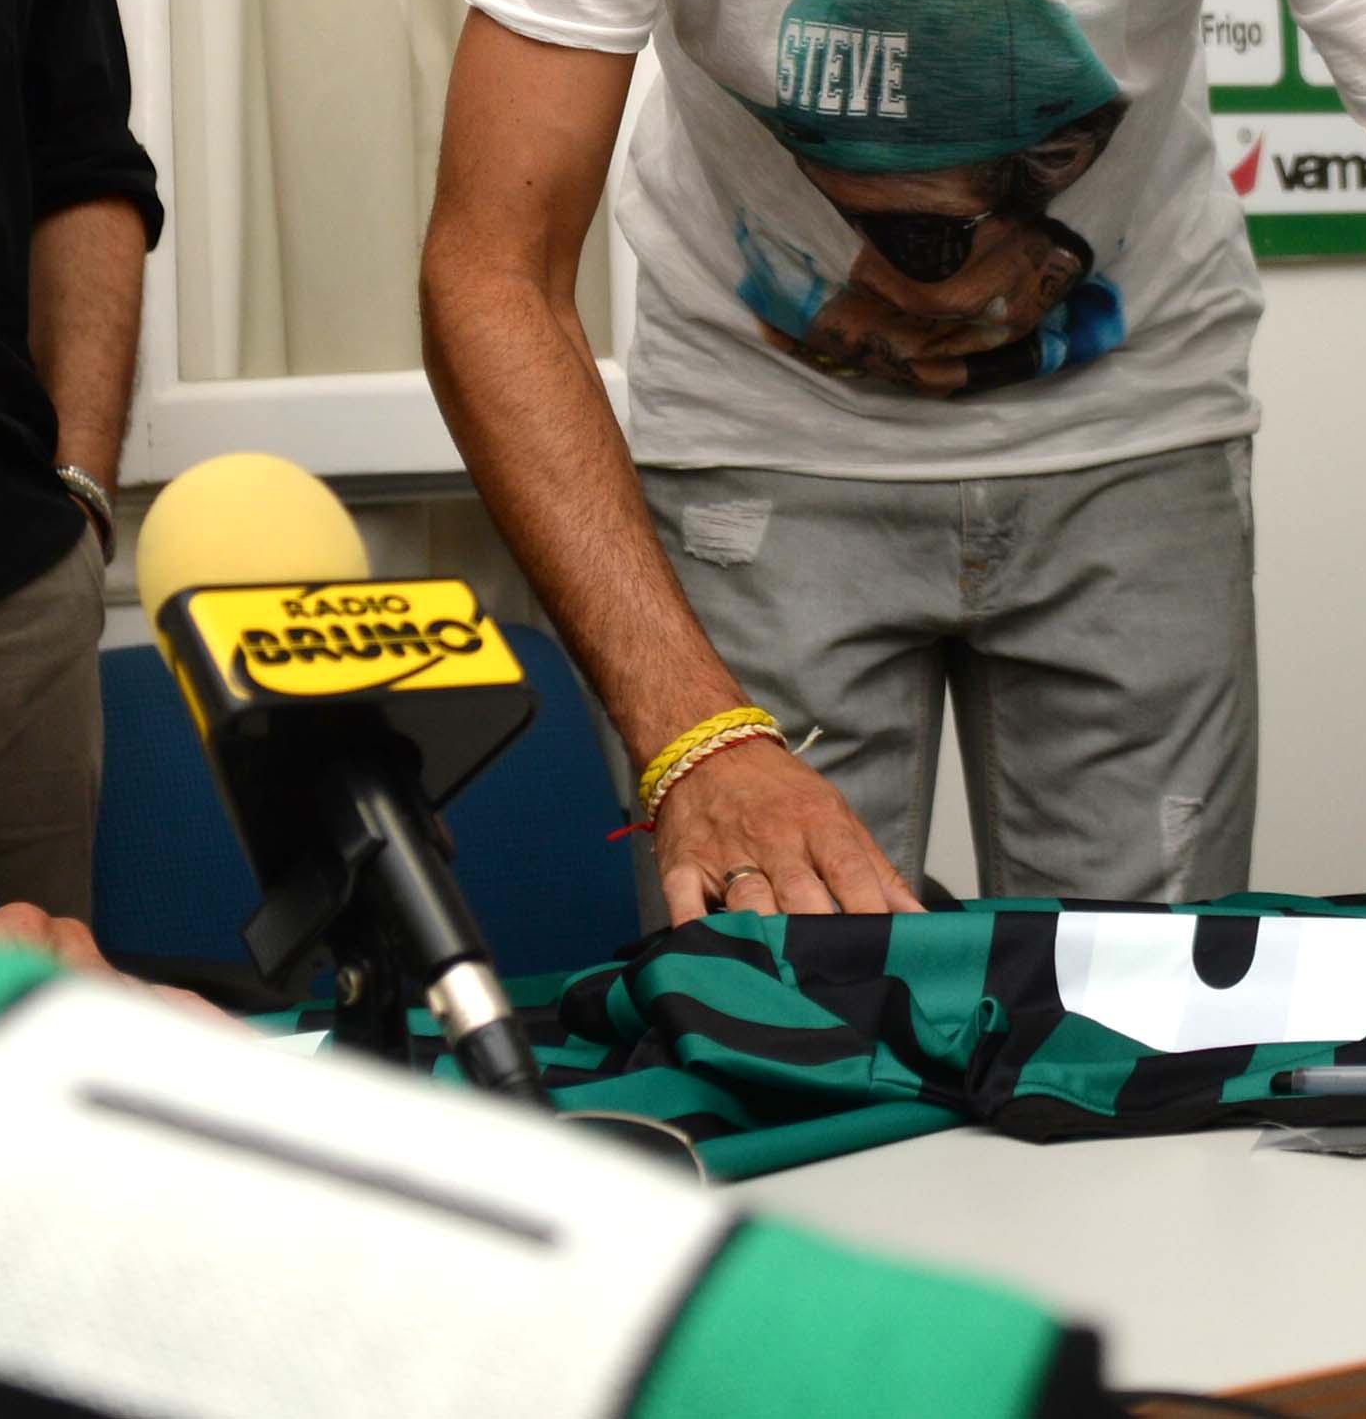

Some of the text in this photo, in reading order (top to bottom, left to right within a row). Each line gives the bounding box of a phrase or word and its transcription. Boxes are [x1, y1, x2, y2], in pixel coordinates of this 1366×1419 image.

[1200, 15, 1263, 54] Frigo
[777, 17, 908, 119] STEVE
[283, 594, 411, 619] RADIO
[242, 618, 483, 665] BRUNO
